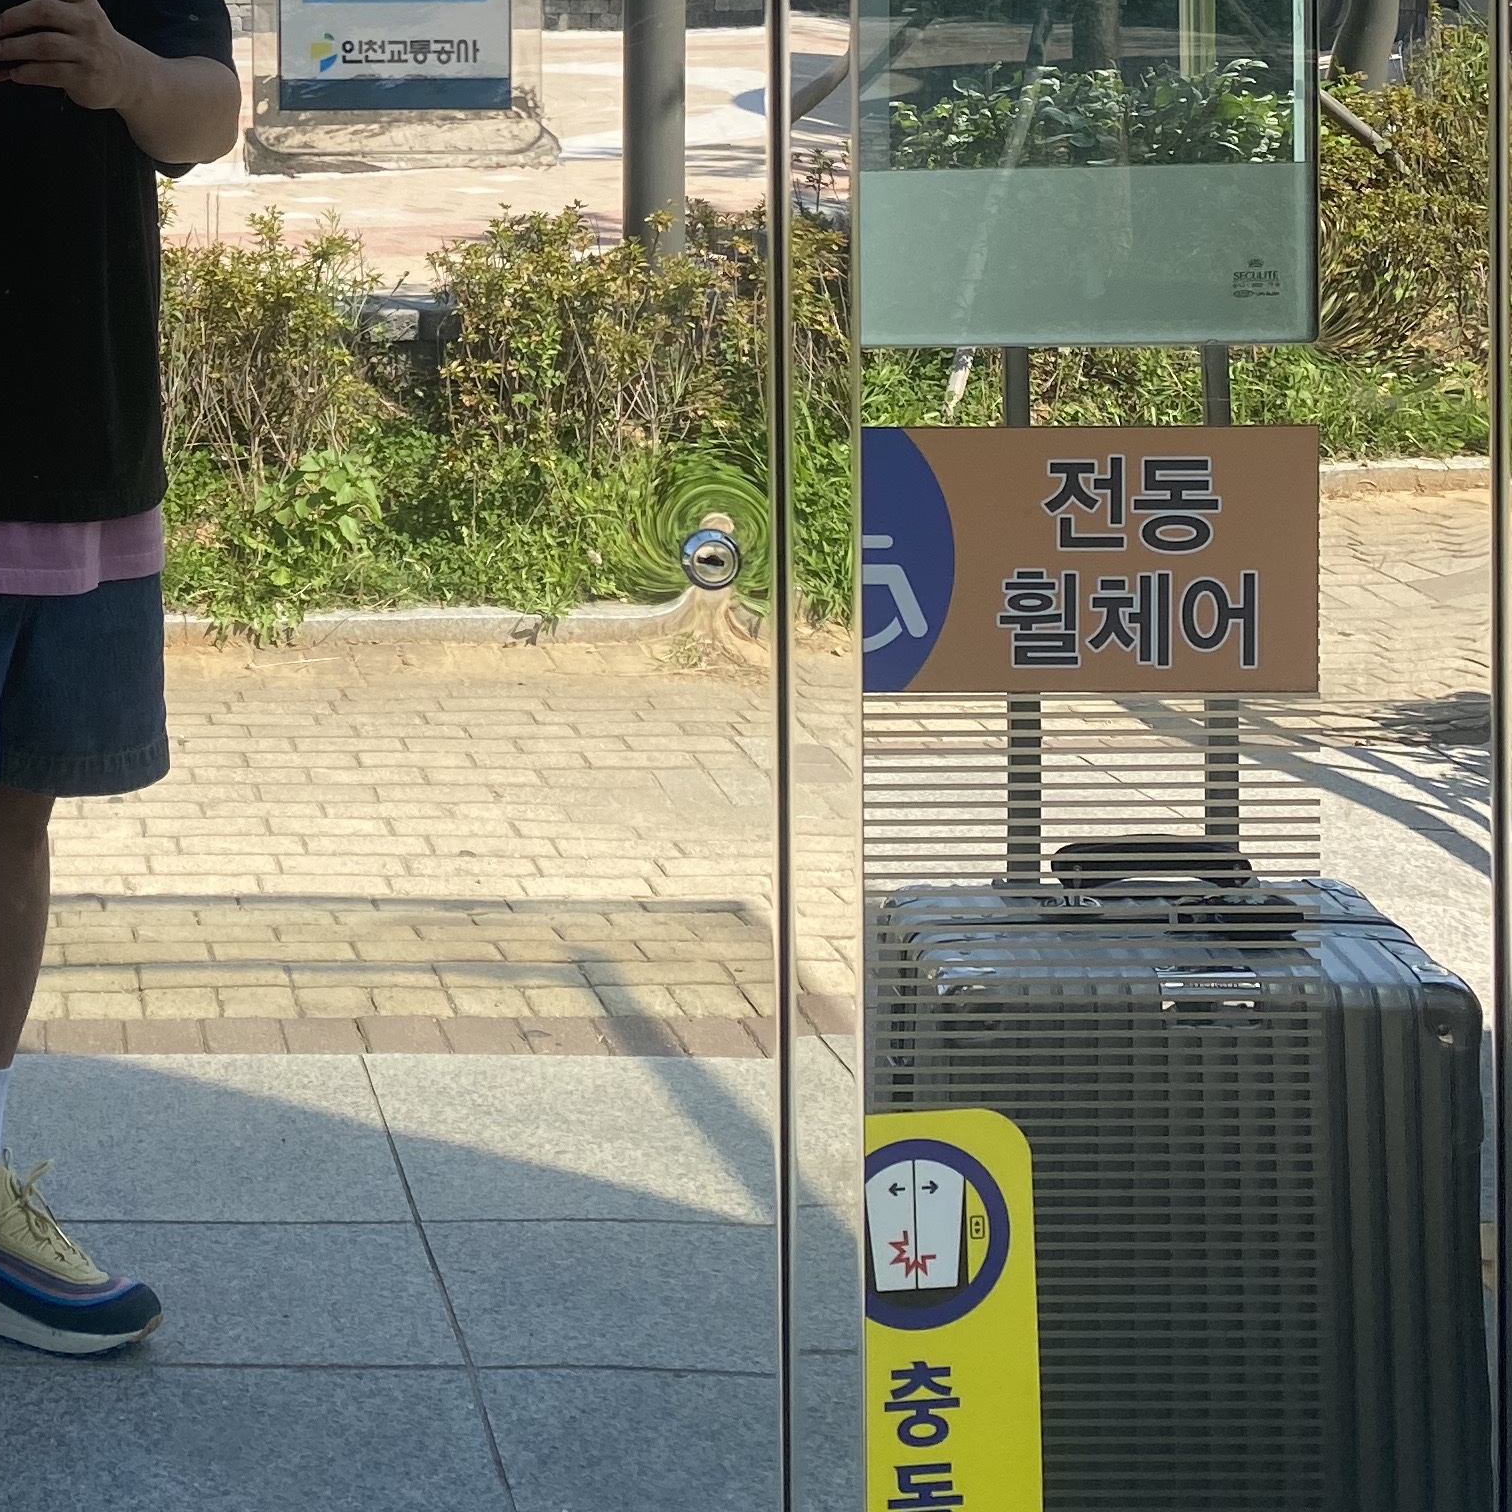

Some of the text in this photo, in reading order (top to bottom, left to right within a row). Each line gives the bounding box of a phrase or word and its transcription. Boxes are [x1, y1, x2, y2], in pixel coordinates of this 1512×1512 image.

[341, 38, 480, 65] 인천교통공사
[1041, 453, 1221, 552] 전동
[997, 568, 1259, 668] 휠체어
